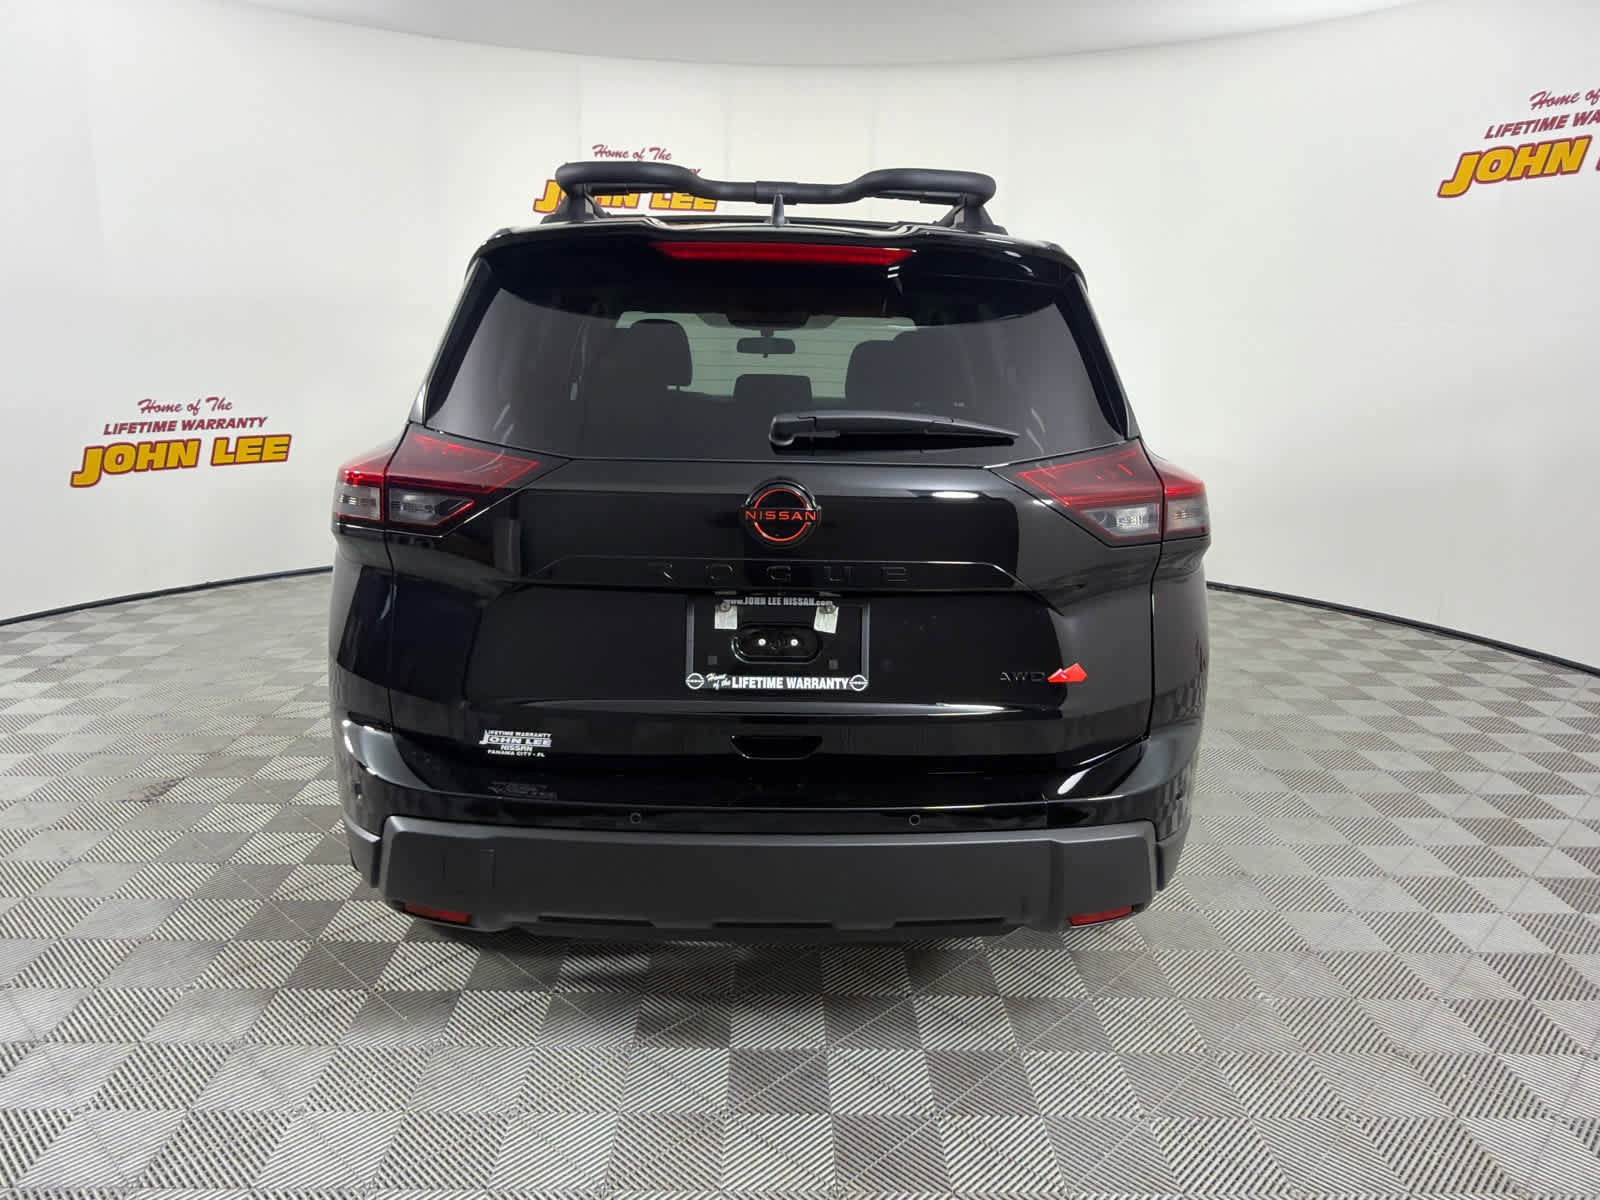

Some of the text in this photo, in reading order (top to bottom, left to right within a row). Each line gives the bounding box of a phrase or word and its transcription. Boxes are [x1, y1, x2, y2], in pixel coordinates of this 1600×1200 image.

[1529, 88, 1600, 110] Home of
[1484, 114, 1570, 139] LIFETIME
[592, 144, 672, 161] Home of The
[1437, 135, 1592, 198] JOHN
[533, 179, 640, 214] JN
[137, 396, 232, 416] Home of The
[103, 416, 268, 436] LIFETIME WARRANTY
[70, 434, 292, 488] JOHN LEE
[744, 510, 817, 521] NISSAN
[648, 560, 908, 582] ROGUE
[768, 596, 781, 606] LEE
[732, 676, 849, 689] LIFETIME WARRANTY
[1000, 671, 1046, 682] AWD
[479, 735, 552, 747] JOHN LEE
